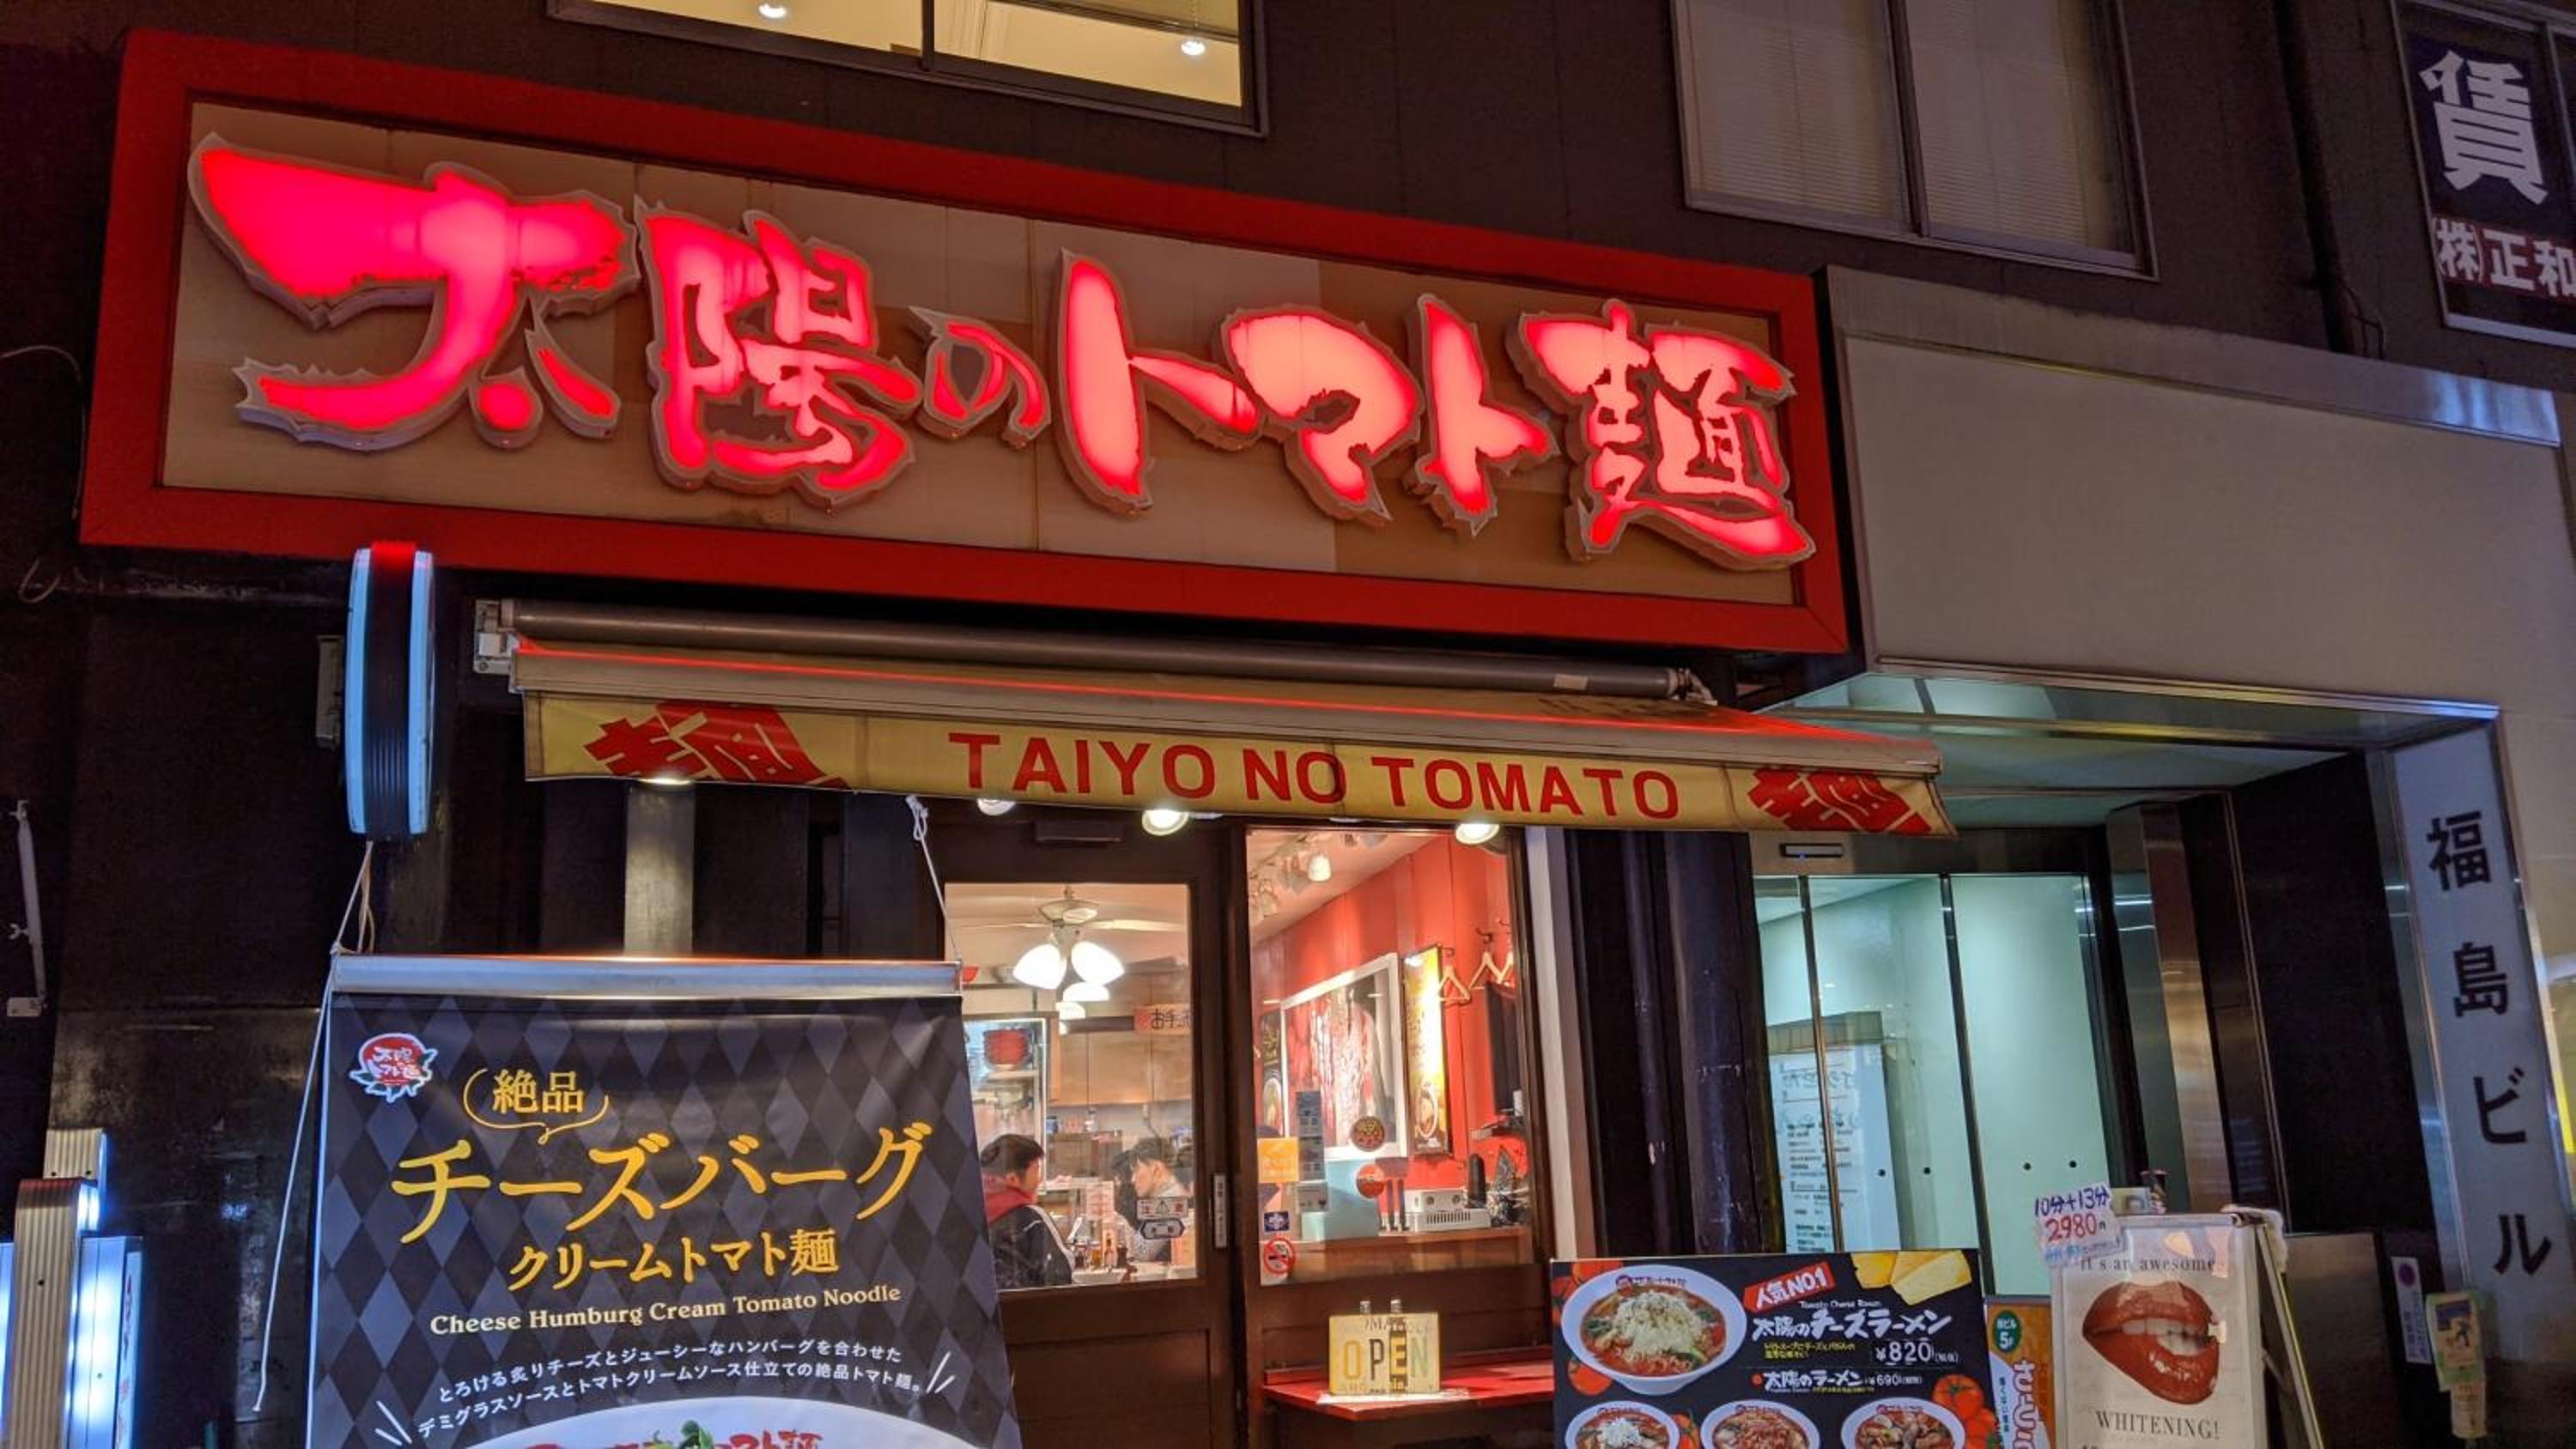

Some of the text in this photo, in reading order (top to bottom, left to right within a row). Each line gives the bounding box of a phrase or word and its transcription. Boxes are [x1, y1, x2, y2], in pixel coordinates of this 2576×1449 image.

[2419, 49, 2548, 205] 賃
[188, 132, 1815, 570] 太陽のトマト麺
[948, 732, 1217, 799] TAIYO
[1243, 748, 1346, 804] NO
[1371, 755, 1680, 820] TOMATO
[2427, 810, 2552, 1276] 福島ビル
[492, 1070, 585, 1115] 絶品
[392, 1121, 933, 1244] チーズバーグ
[507, 1228, 839, 1293] クリームトマト麺
[429, 1282, 901, 1336] Cheese Humburg Cream Tomato Noodle
[1752, 1307, 1953, 1343] 太陽のチーズラーメン
[1344, 1337, 1430, 1381] OPEN
[1763, 1369, 1863, 1391] 太陽のラーメン
[2095, 1410, 2220, 1440] WHITENING!
